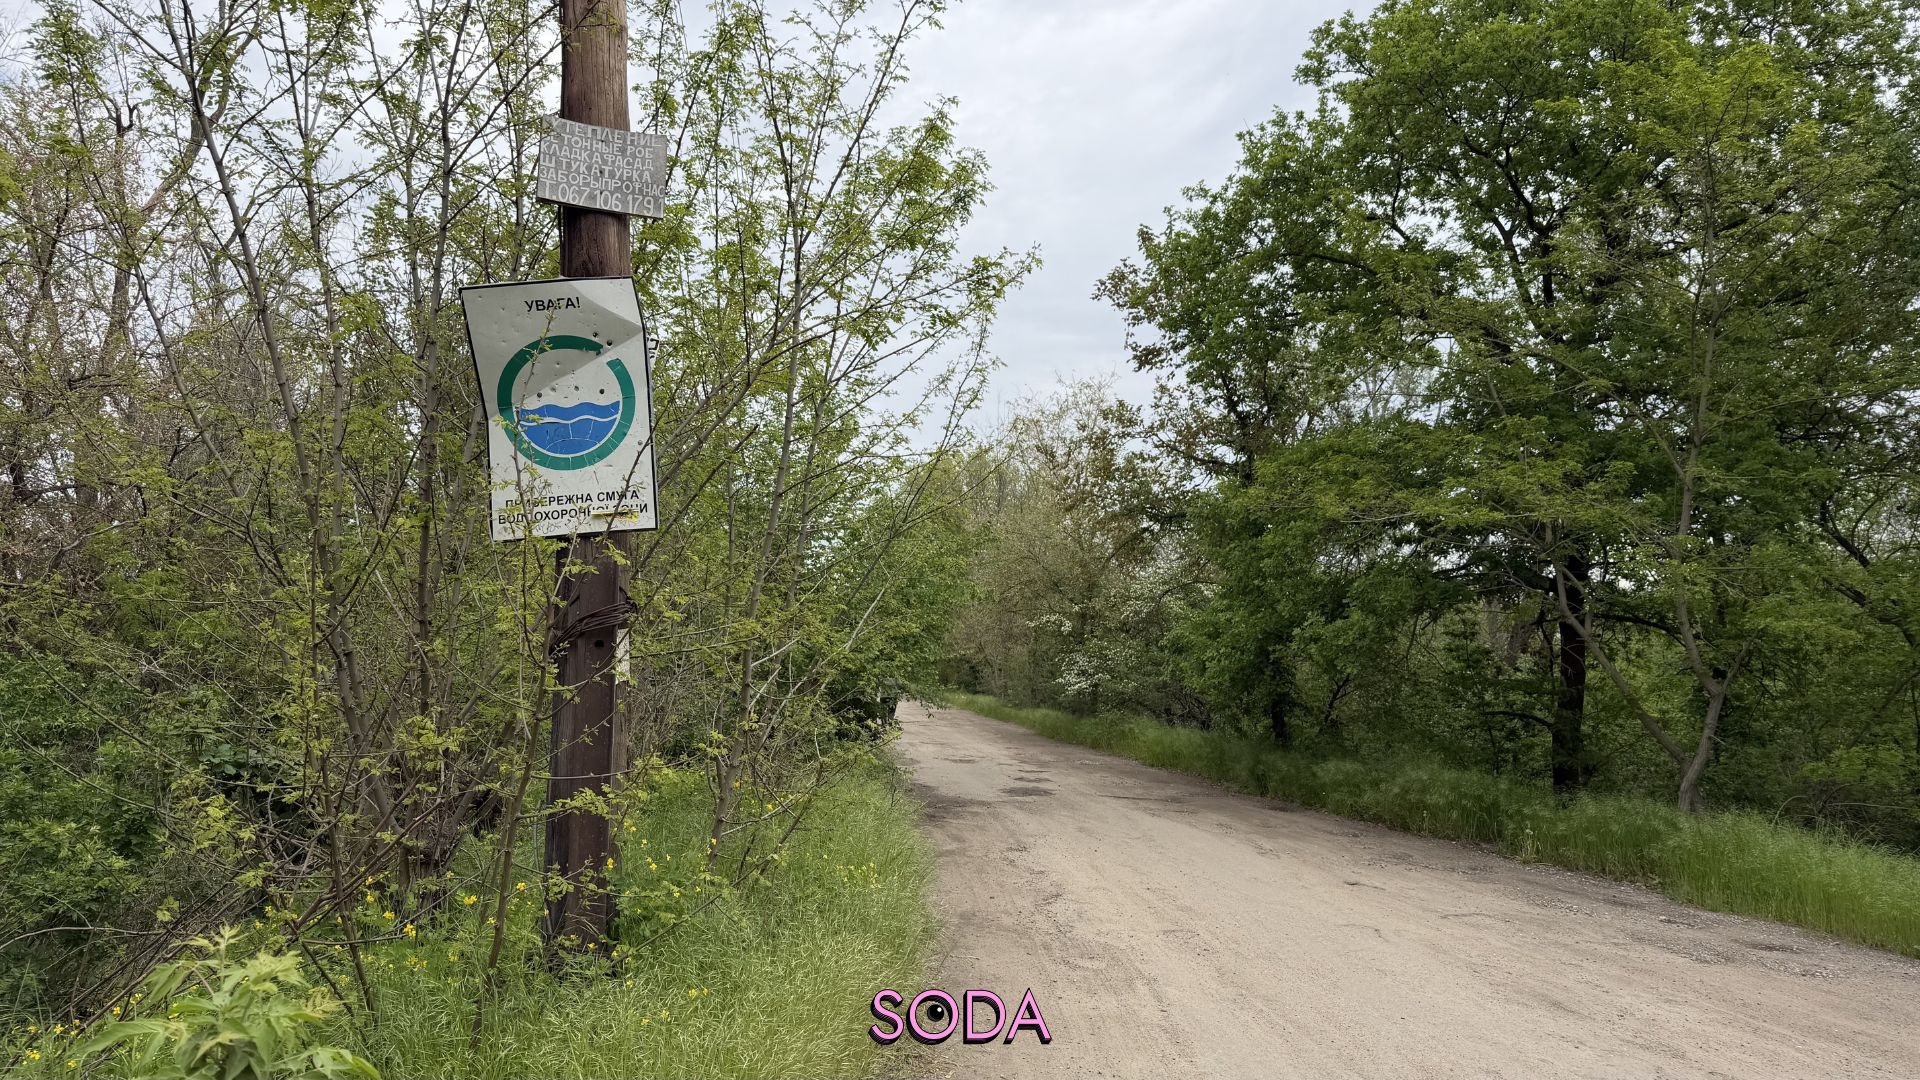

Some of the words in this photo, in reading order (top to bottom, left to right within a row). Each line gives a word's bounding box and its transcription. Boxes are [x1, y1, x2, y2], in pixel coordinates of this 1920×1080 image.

[542, 133, 622, 155] ЕТОННЫЕ
[626, 146, 654, 159] РОБ
[540, 154, 652, 183] ШТУКАТУРКА
[524, 297, 580, 312] УВАГА!
